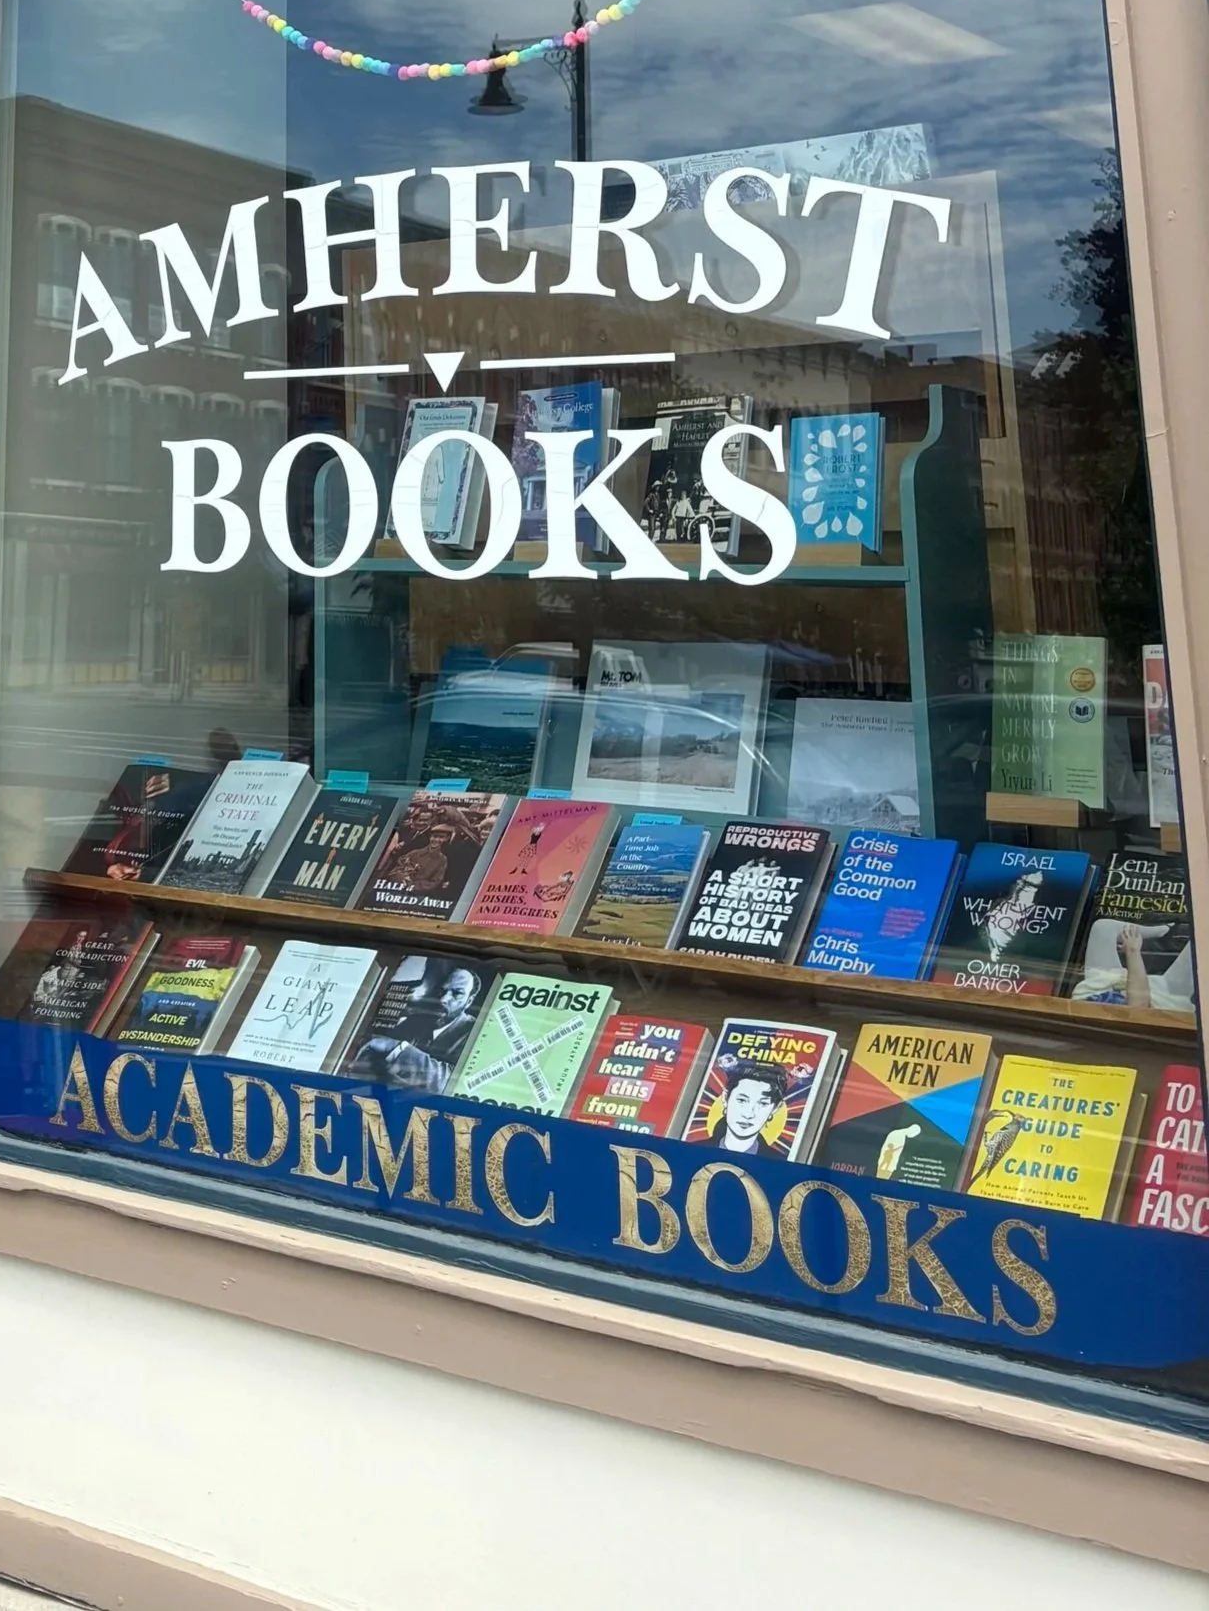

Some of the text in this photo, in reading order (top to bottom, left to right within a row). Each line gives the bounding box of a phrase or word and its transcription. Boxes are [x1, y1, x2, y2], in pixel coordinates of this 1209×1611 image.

[57, 160, 952, 386] AMHERST
[823, 454, 862, 465] ROBERT
[825, 463, 859, 474] FROST
[160, 423, 798, 586] BOOKS
[1001, 641, 1060, 663] THINGS
[1002, 668, 1017, 685] IN
[1001, 692, 1058, 714] NATURE
[1002, 719, 1056, 740] MERELY
[1001, 742, 1041, 764] GROW
[1000, 768, 1036, 791] Yiyun
[1041, 771, 1052, 792] Li
[215, 792, 278, 807] CRIMINAL
[218, 808, 259, 822] STATE
[303, 820, 379, 852] EVERY
[724, 832, 817, 853] WRONGS
[726, 825, 821, 841] REPRODUCTIVE
[850, 836, 899, 855] Crisis
[843, 854, 893, 873] of the
[1000, 852, 1057, 871] ISRAEL
[1109, 852, 1158, 875] Lena
[293, 860, 346, 891] MAN
[708, 869, 804, 890] A SHORT
[838, 868, 917, 891] Common
[486, 883, 529, 895] DAMES,
[702, 883, 800, 905] HISTORY
[833, 882, 882, 901] Good
[375, 891, 453, 910] WORLD AWAY
[481, 894, 527, 907] DISHES,
[699, 896, 794, 915] OF BAD IDEAS
[963, 897, 1067, 922] WHAT WENT
[478, 905, 559, 920] AND DEGREES
[693, 906, 789, 931] ABOUT
[970, 912, 1050, 934] WRONG?
[1096, 907, 1144, 919] A Memoir
[688, 922, 784, 947] WOMEN
[813, 934, 859, 955] Chris
[55, 949, 129, 963] CONTRADICTION
[807, 950, 875, 975] Murphy
[967, 959, 1020, 979] OMER
[283, 975, 338, 992] GIANT
[498, 982, 600, 1013] against
[148, 1013, 189, 1025] ACTIVE
[118, 1030, 200, 1048] BYSTANDERSHIP
[640, 1024, 681, 1041] you
[727, 1031, 817, 1054] DEFYING
[252, 1049, 296, 1063] ROBERT
[737, 1046, 797, 1064] CHINA
[867, 1034, 976, 1066] AMERICAN
[599, 1058, 644, 1077] hear
[887, 1060, 941, 1088] MEN
[610, 1080, 649, 1098] this
[1052, 1077, 1075, 1090] THE
[588, 1097, 637, 1118] from
[1001, 1089, 1121, 1118] CREATURES'
[1166, 1082, 1196, 1113] TO
[1023, 1117, 1084, 1139] GUIDE
[1040, 1144, 1054, 1154] TO
[1004, 1158, 1079, 1183] CARING
[50, 1042, 1058, 1338] ACADEMIC BOOKS
